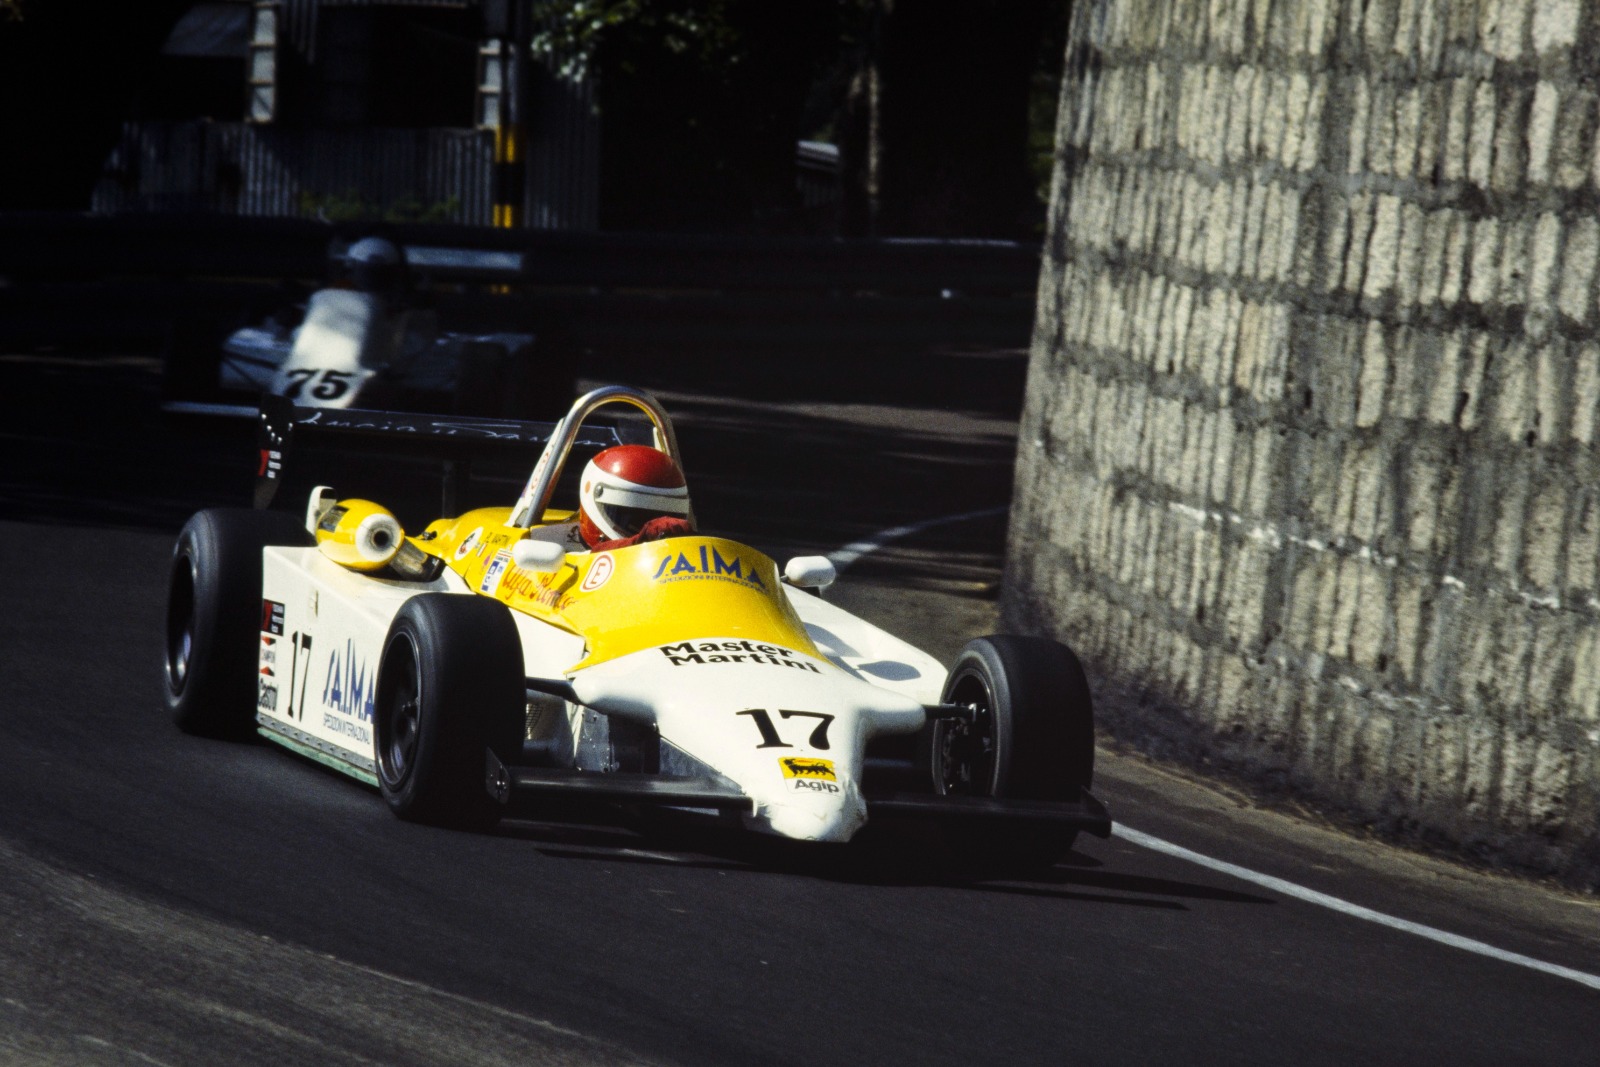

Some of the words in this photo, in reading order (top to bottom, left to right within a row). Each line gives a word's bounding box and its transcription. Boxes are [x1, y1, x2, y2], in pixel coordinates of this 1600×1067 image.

[283, 369, 355, 400] 75
[590, 562, 606, 585] E
[659, 640, 793, 658] Master
[666, 653, 823, 675] Martini
[287, 630, 313, 723] 17
[735, 708, 836, 751] 17
[795, 779, 839, 793] Agip
